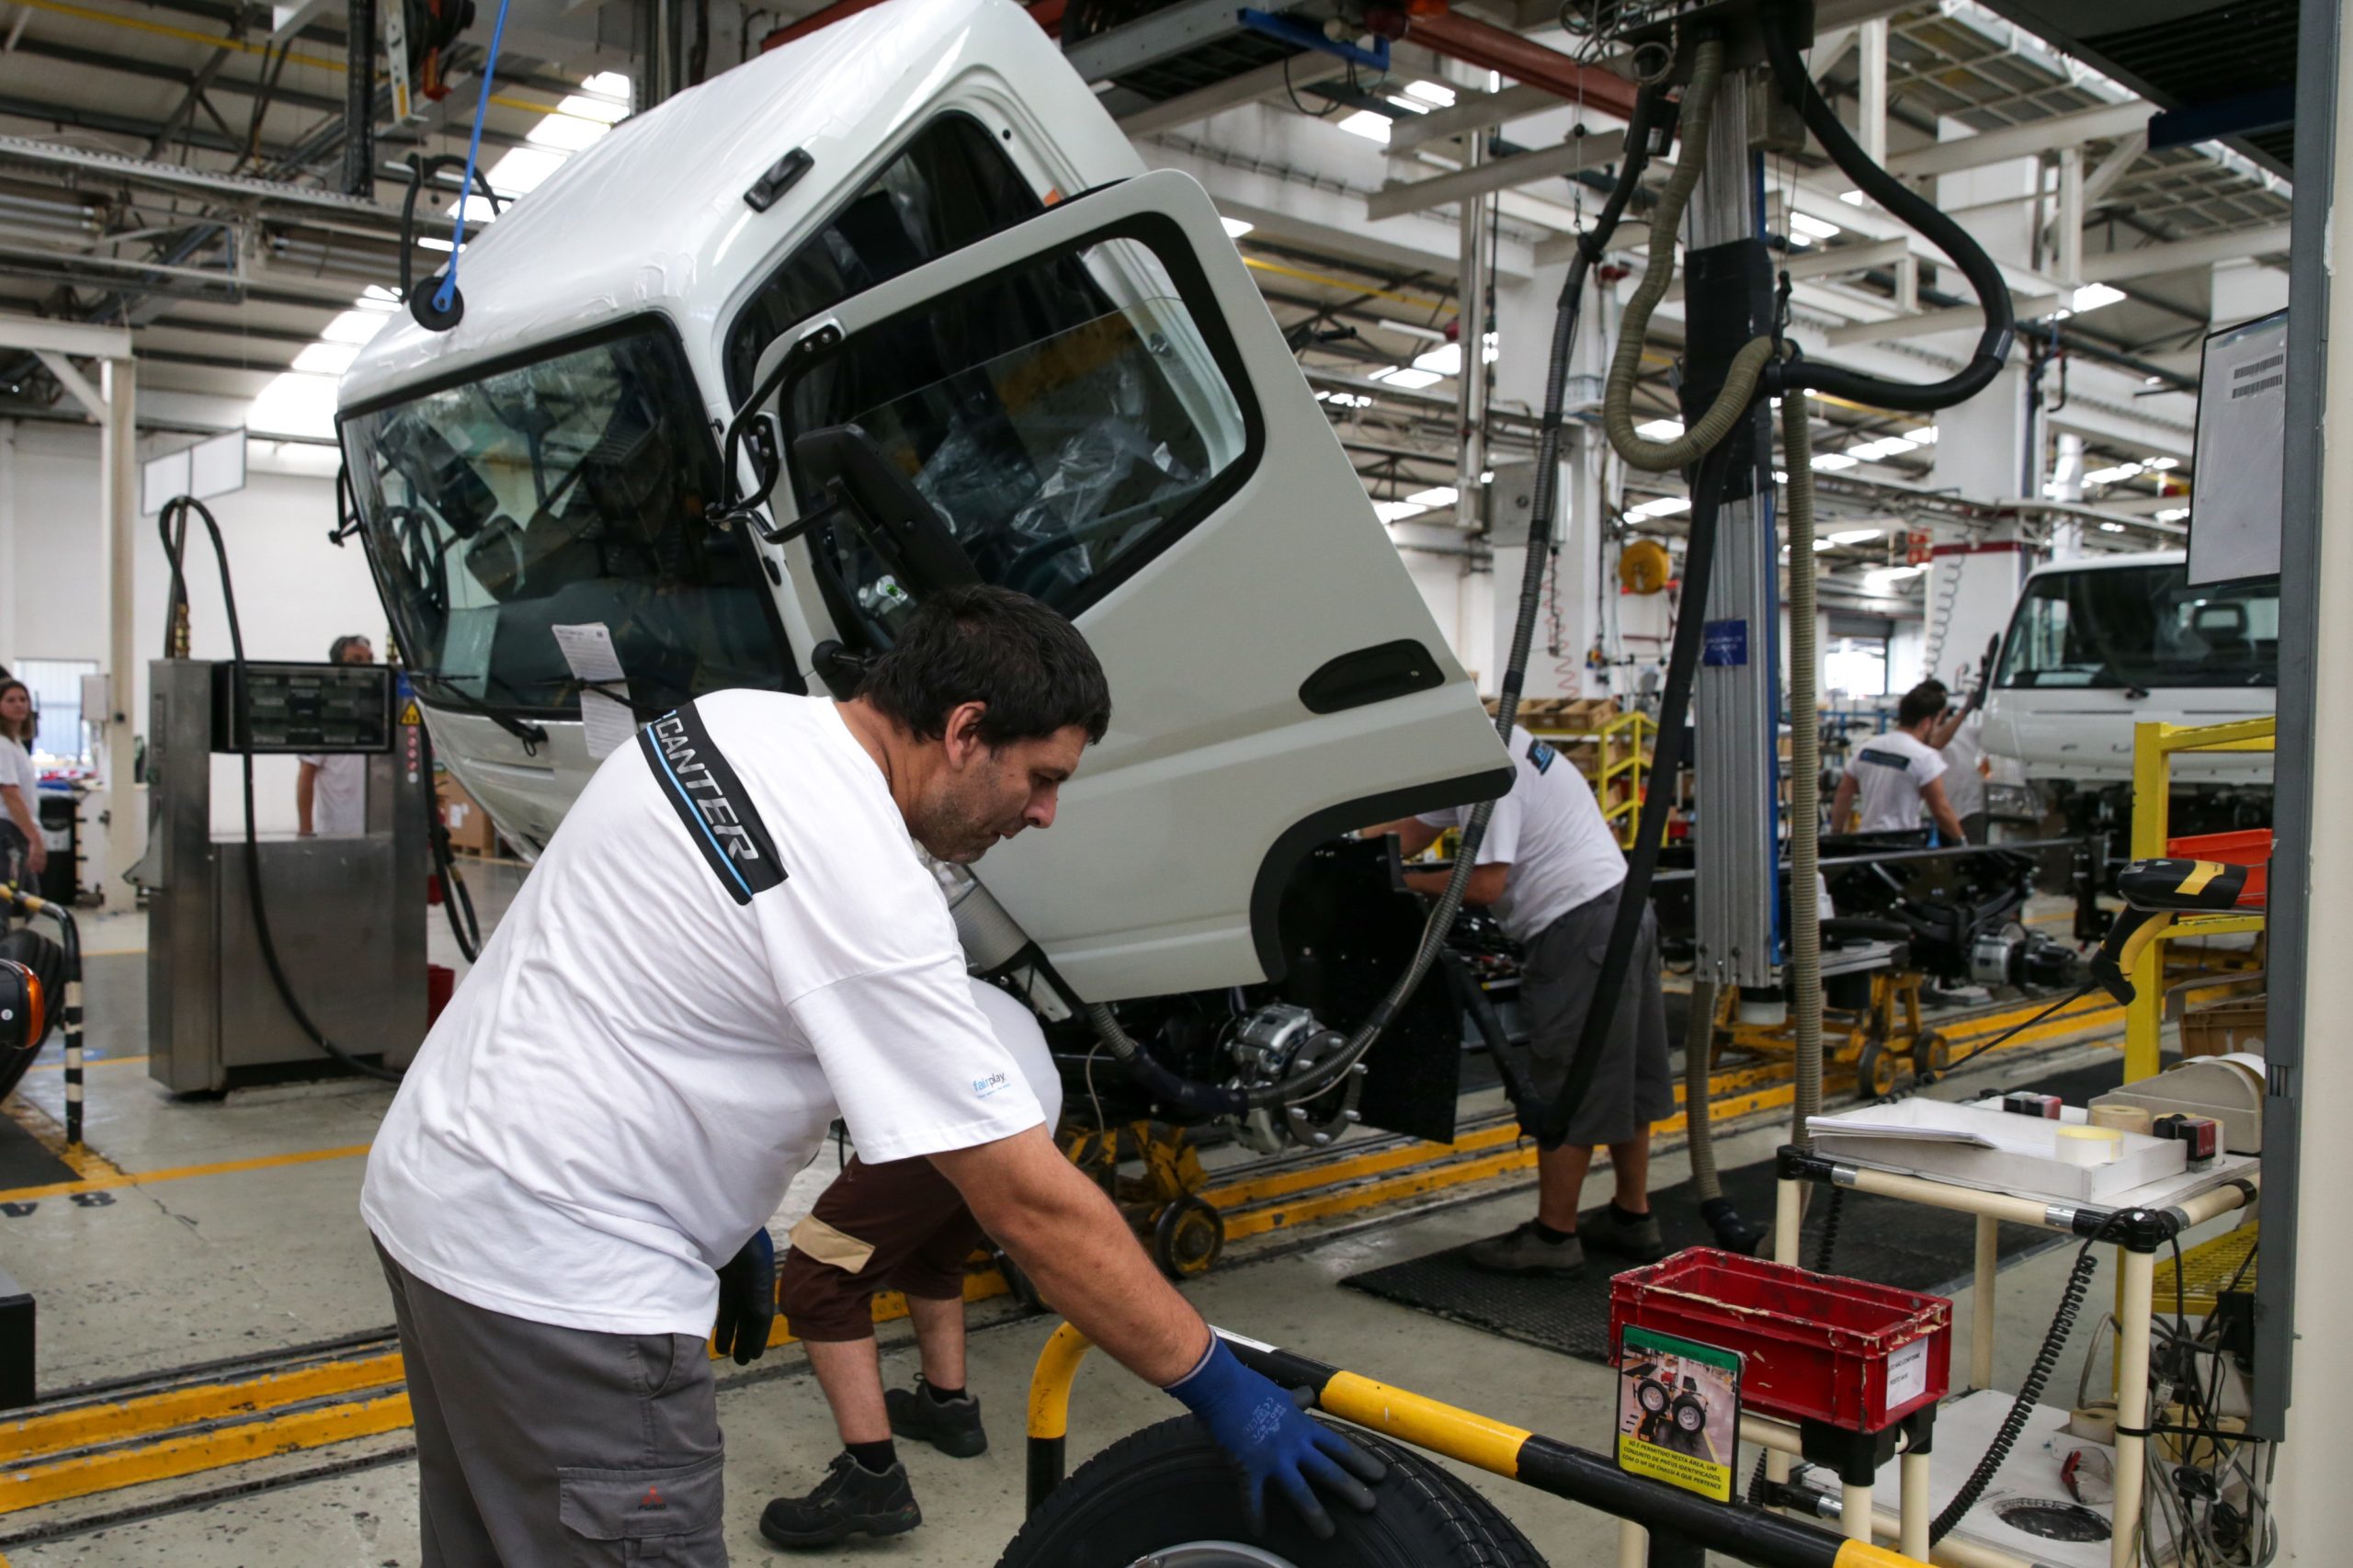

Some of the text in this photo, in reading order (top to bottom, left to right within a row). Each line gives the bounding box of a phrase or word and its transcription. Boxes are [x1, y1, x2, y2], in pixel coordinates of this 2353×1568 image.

[1621, 1453, 1634, 1462] COM
[1680, 1472, 1692, 1482] QUE
[1693, 1477, 1721, 1490] PERTENCE
[1623, 1447, 1652, 1460] CONJUNTO
[1660, 1459, 1677, 1468] PNEUS
[1641, 1443, 1670, 1457] PERMITIDO
[1671, 1452, 1688, 1463] NESTA
[1706, 1464, 1718, 1472] UM
